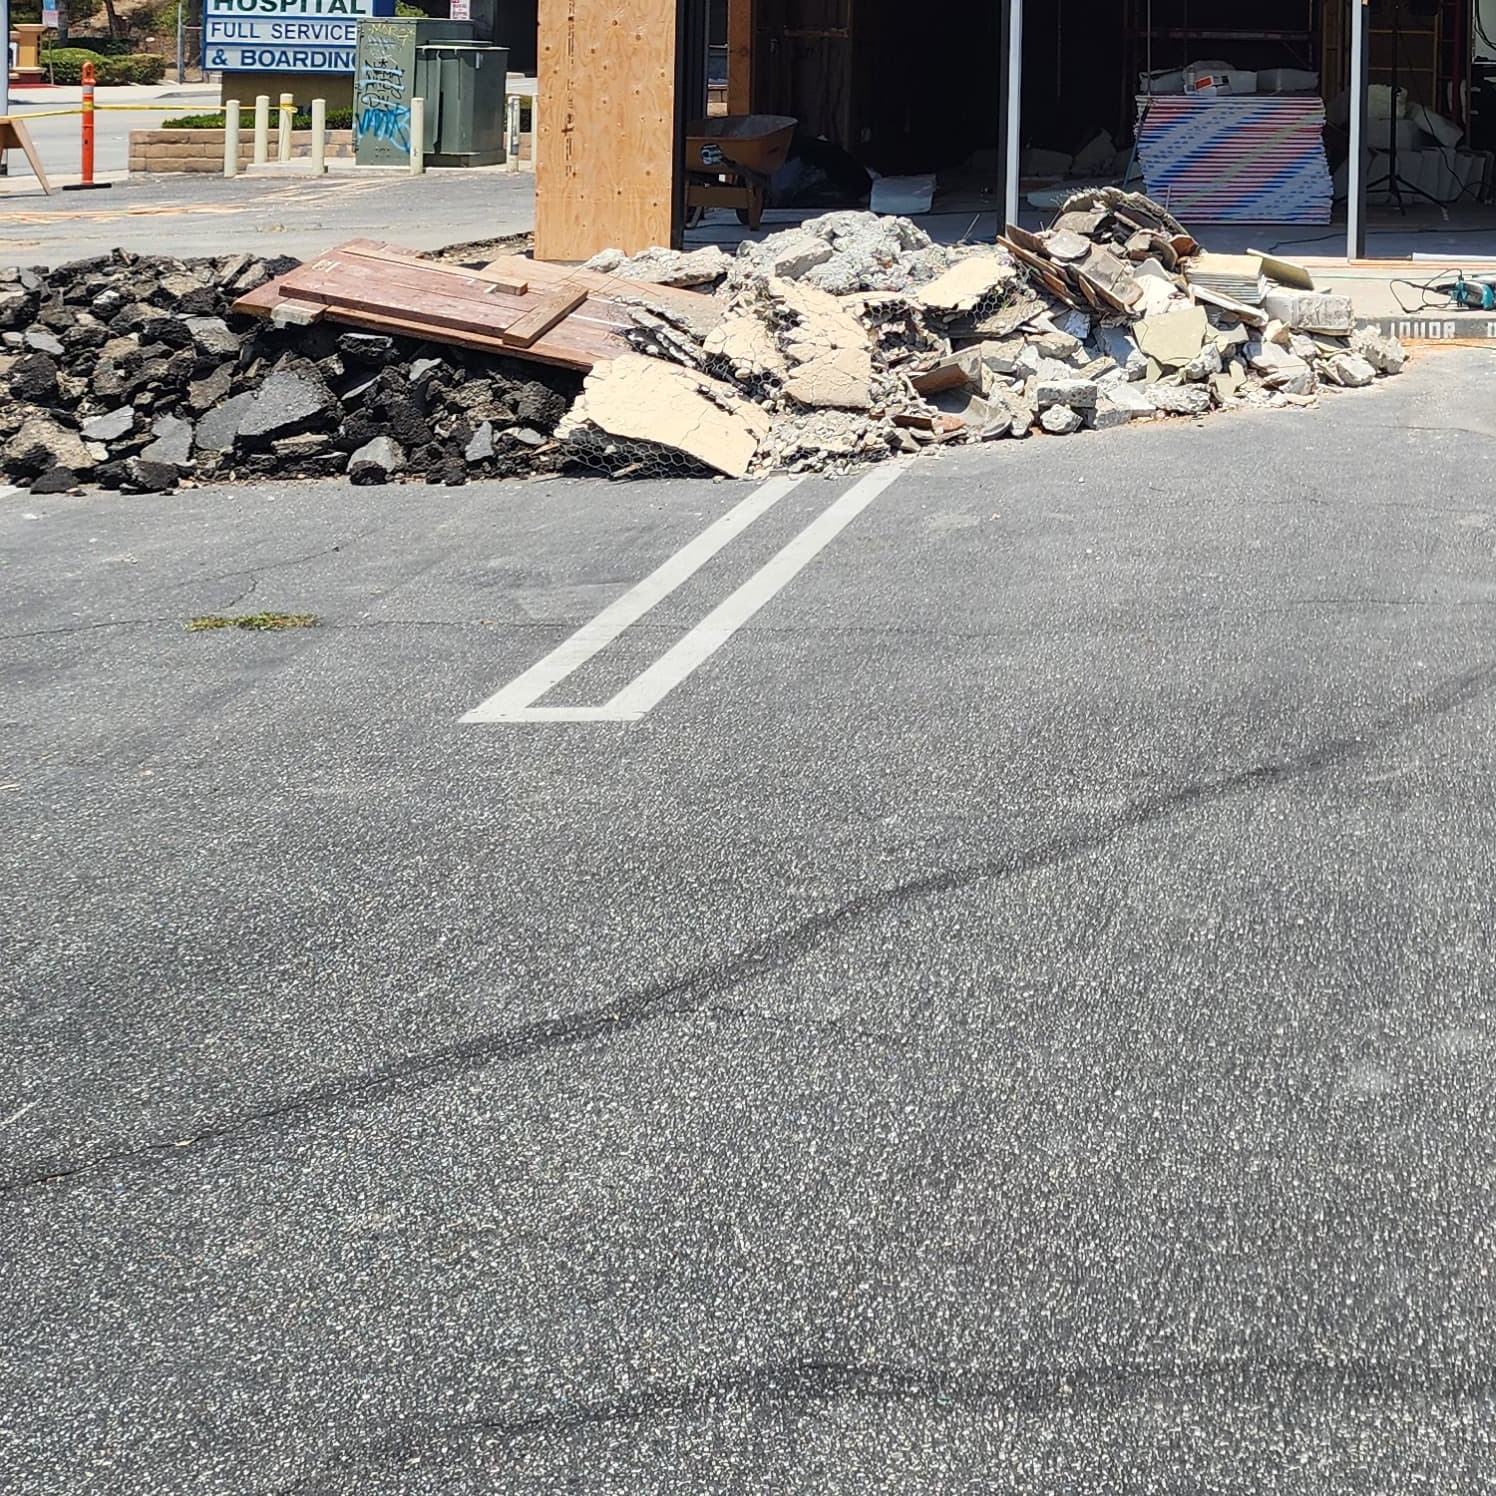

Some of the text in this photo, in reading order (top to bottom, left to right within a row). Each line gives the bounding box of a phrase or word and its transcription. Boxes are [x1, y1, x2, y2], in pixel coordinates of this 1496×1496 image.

[211, 21, 261, 39] FULL
[271, 23, 356, 41] SERVICE
[211, 48, 356, 69] & BOARDIN
